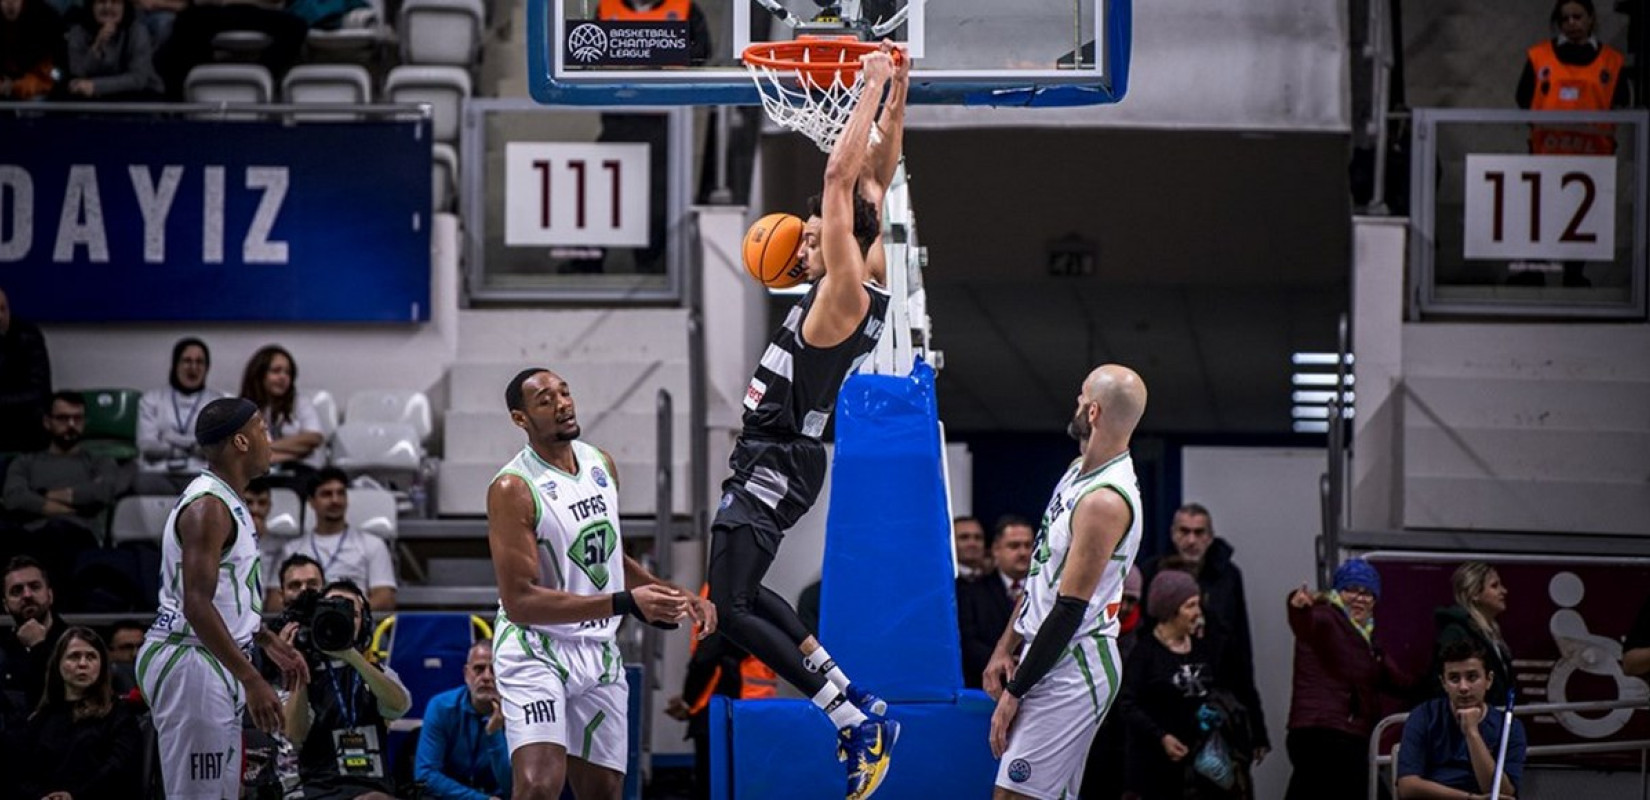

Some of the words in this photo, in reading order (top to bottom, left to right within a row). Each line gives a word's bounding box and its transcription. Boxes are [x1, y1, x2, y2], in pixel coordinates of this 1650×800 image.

[609, 29, 677, 38] BASKETBALL
[609, 38, 686, 49] CHAMPIONS
[609, 49, 651, 58] LEAGUE
[532, 160, 621, 229] 111
[1484, 171, 1597, 243] 112
[583, 528, 606, 566] 57
[523, 700, 556, 725] FIAT
[190, 753, 224, 780] FIAT
